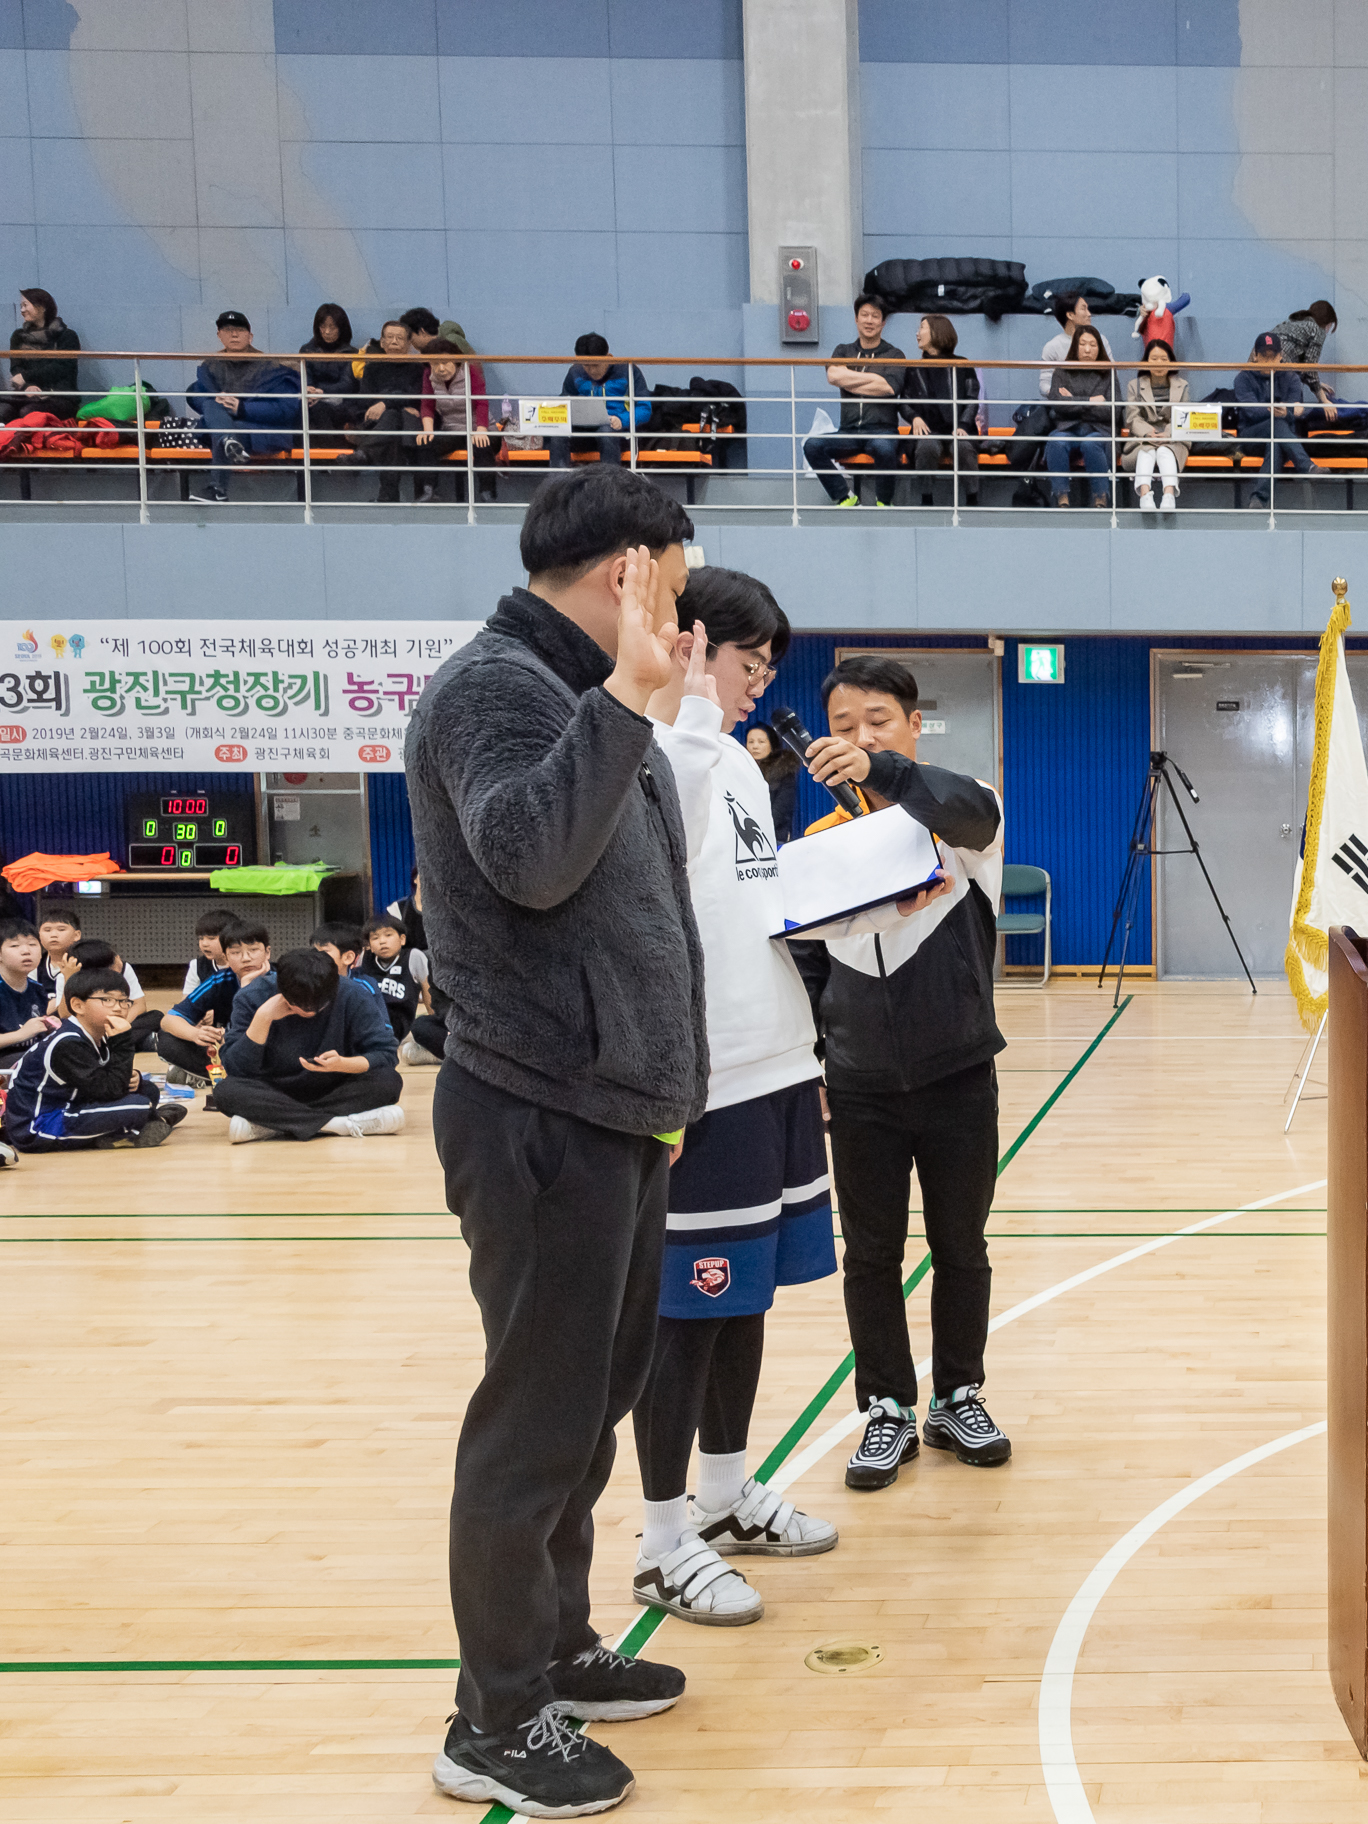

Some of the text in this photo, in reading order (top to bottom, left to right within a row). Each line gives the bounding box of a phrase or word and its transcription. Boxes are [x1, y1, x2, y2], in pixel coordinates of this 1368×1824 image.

[137, 638, 192, 658] 100회
[200, 638, 314, 658] 전국체육대회
[322, 638, 397, 659] 성공개최
[0, 669, 434, 712] 3회 광진구청장기 농구
[0, 727, 23, 741] 일시
[32, 727, 75, 740] 2019년
[137, 726, 175, 740] 3월3일
[185, 726, 226, 740] (개회식
[230, 726, 278, 740] 2월24일
[284, 726, 337, 740] 11시30분
[343, 726, 406, 741] 중곡문화체
[218, 746, 330, 761] 주최 광진구체육회
[362, 747, 388, 761] 주관
[146, 820, 156, 837] 0
[176, 824, 196, 840] 30
[215, 820, 225, 837] 0
[161, 846, 175, 865] 0
[181, 850, 192, 867] 0
[225, 846, 239, 865] 0
[377, 977, 406, 999] ERS
[698, 1260, 725, 1269] STEPUP
[503, 1749, 527, 1759] FILA
